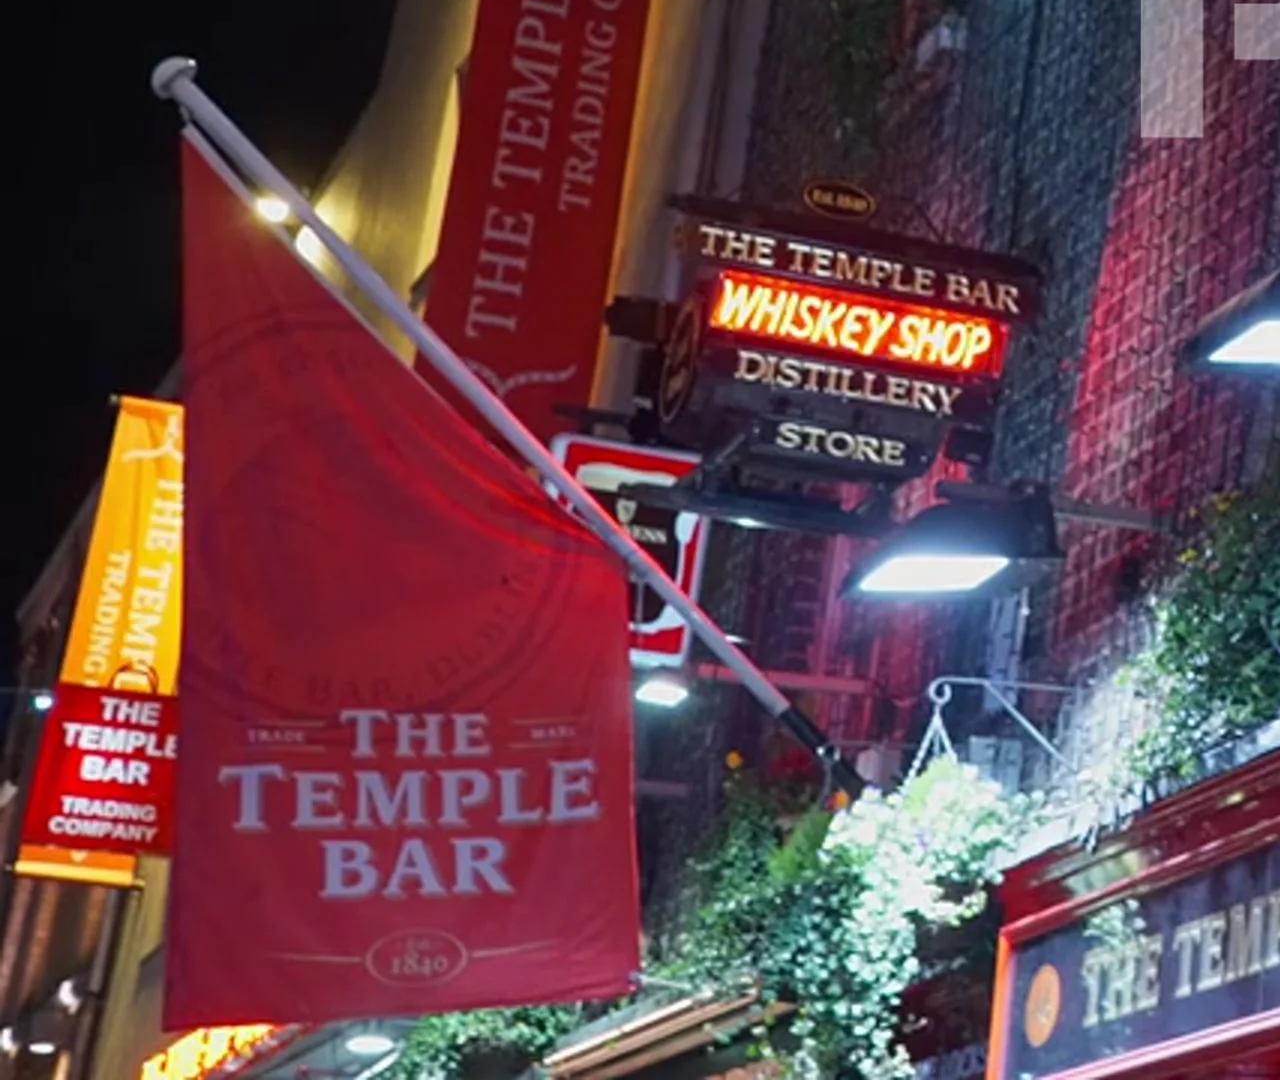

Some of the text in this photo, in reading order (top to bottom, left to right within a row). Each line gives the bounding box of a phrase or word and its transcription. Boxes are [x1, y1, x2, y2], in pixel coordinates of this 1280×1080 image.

[559, 18, 620, 213] TRADING
[465, 205, 536, 338] THE
[700, 225, 1021, 315] THE TEMPLE BAR
[720, 278, 991, 369] WHISKEY SHOP
[734, 350, 961, 416] DISTILLERY
[775, 421, 905, 467] STORE
[83, 550, 131, 675] TRADING
[112, 563, 173, 694] TEMPL
[62, 722, 178, 759] TEMPLE
[101, 696, 162, 727] THE
[339, 708, 493, 758] THE
[79, 756, 151, 787] BAR
[218, 758, 600, 834] TEMPLE
[48, 816, 158, 844] COMPANY
[60, 795, 157, 821] TRADING
[318, 836, 516, 900] BAR
[1081, 934, 1163, 1027] THE
